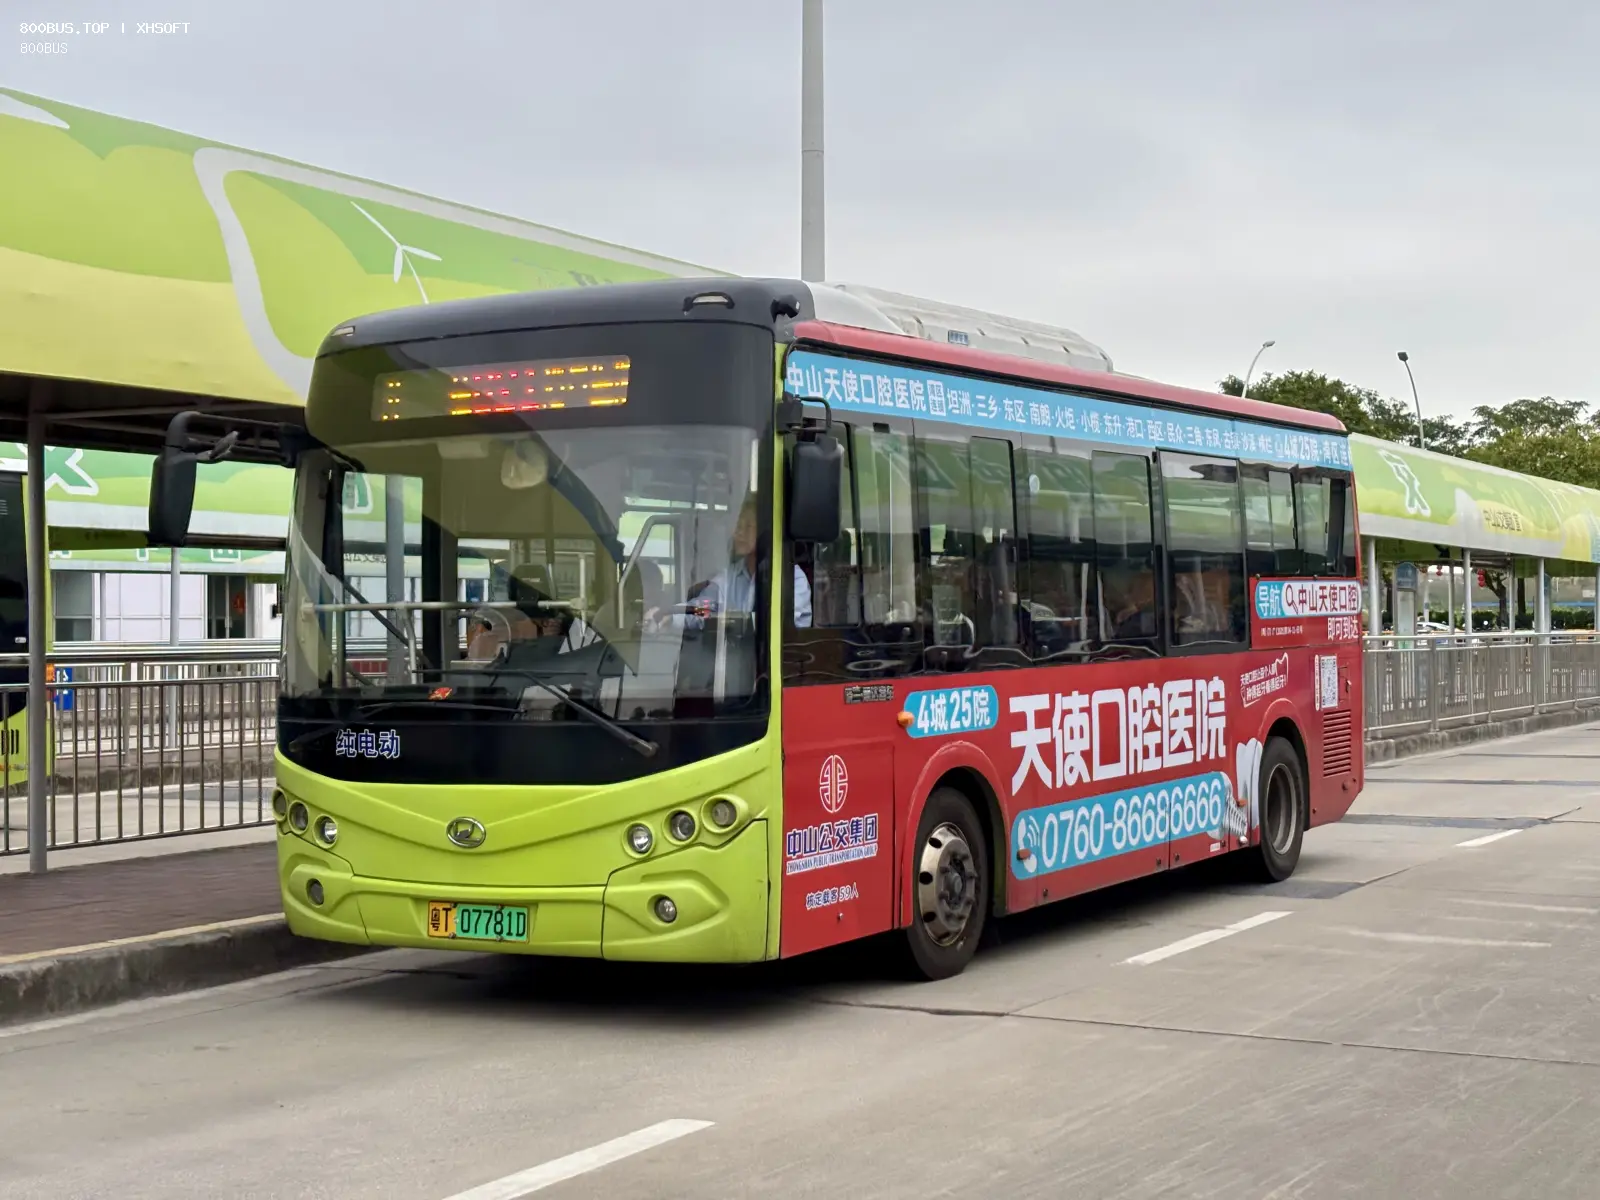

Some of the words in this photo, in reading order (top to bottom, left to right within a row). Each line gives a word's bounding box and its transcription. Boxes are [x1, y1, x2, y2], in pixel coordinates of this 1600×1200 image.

[785, 361, 927, 413] 中山天使口腔医院
[1259, 585, 1281, 616] 导航
[1298, 583, 1358, 613] 中山天使口腔
[1327, 616, 1359, 640] 即可到达
[917, 689, 991, 735] 4城25院
[336, 729, 401, 759] 纯电动
[1009, 676, 1226, 797] 天使口腔医院
[786, 813, 879, 858] 中山公交集团
[1041, 777, 1222, 870] 0760-86686666
